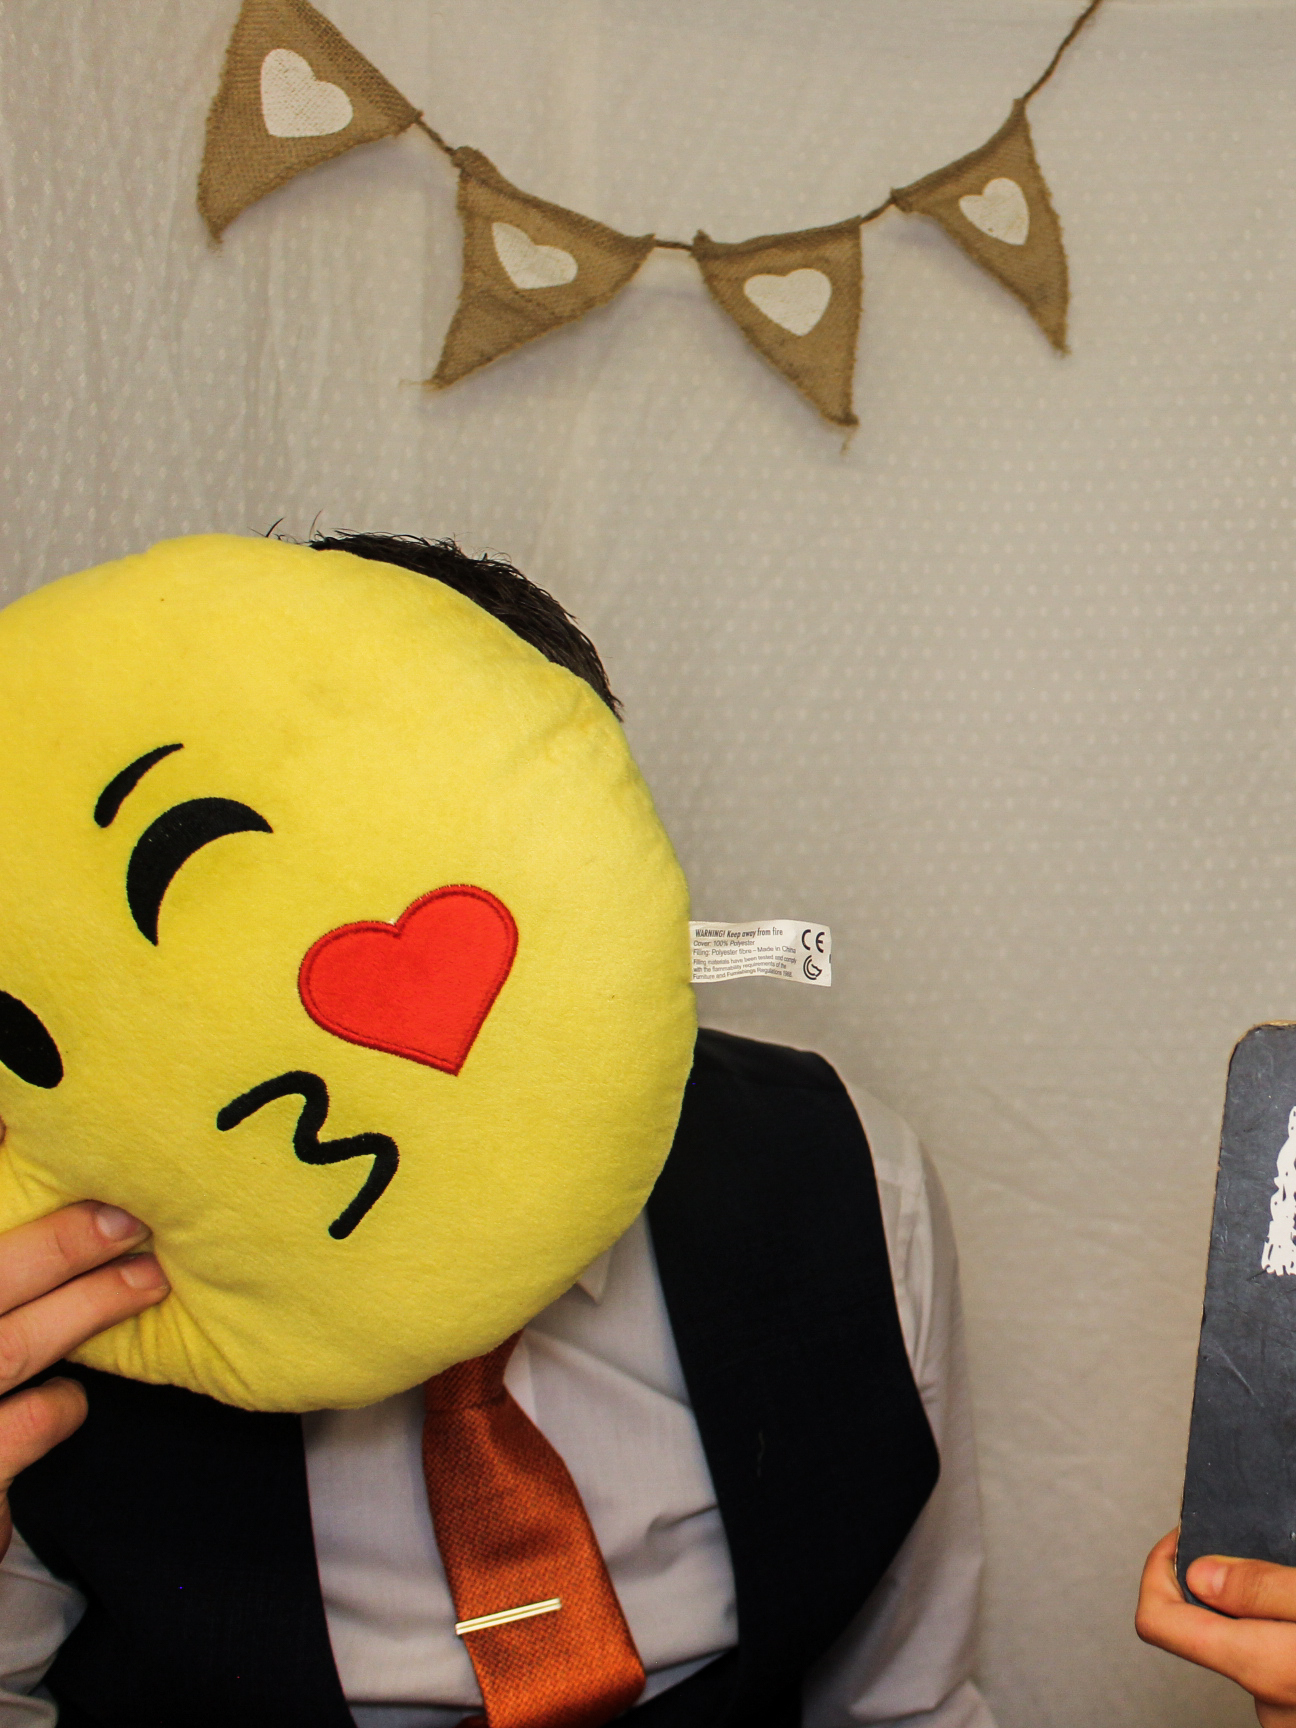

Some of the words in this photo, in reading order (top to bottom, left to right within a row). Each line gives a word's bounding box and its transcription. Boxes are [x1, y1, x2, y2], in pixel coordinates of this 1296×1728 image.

[695, 929, 726, 938] WARNING!
[726, 930, 741, 939] Keep
[757, 927, 771, 936] from
[772, 926, 783, 936] fire
[712, 949, 737, 957] Polyester
